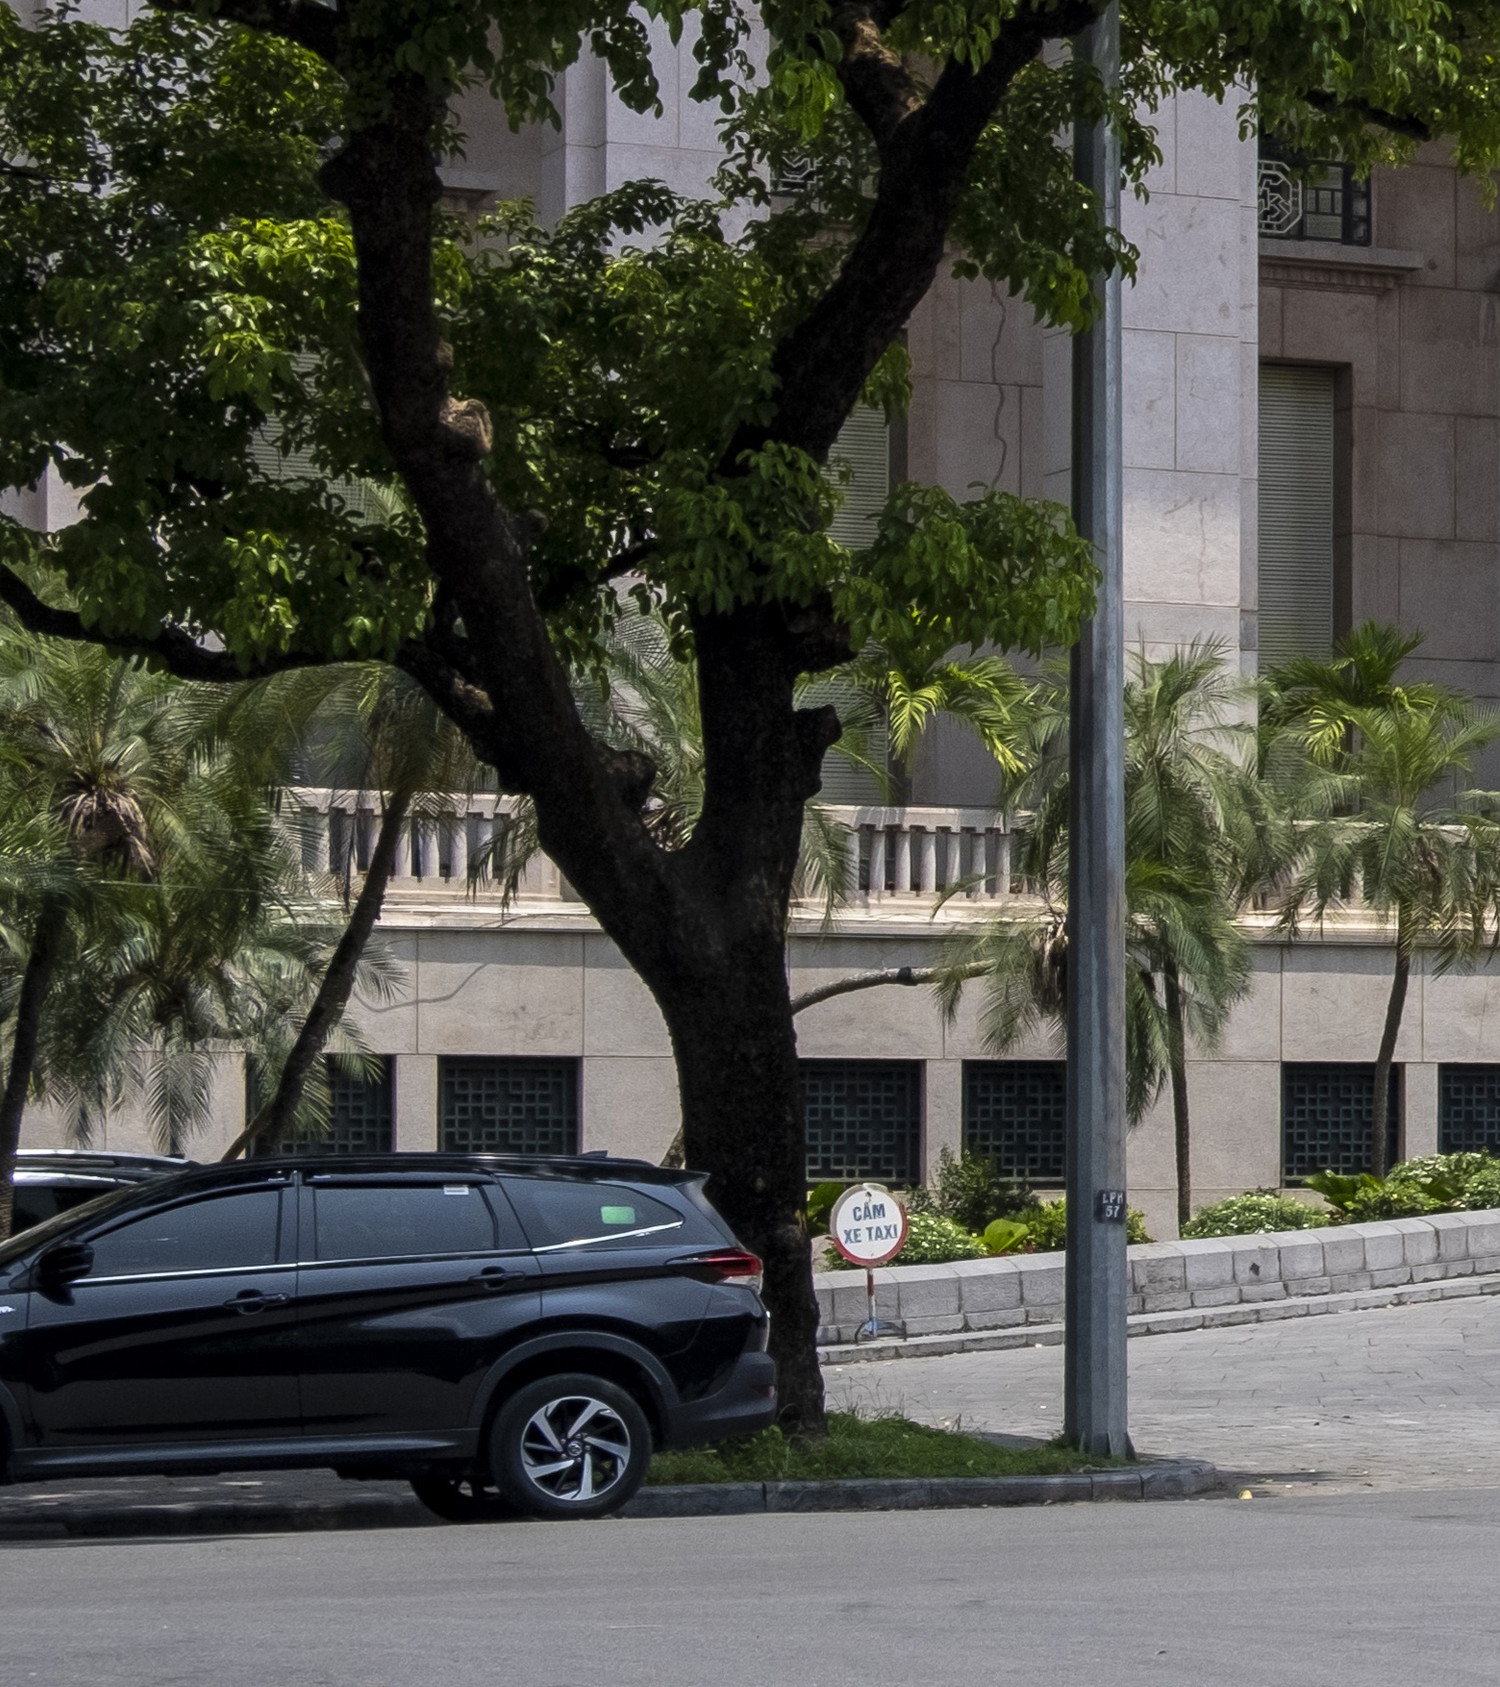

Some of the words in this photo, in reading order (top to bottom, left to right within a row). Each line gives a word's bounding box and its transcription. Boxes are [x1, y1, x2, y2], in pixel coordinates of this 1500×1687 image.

[1106, 1205, 1120, 1218] 57
[844, 1228, 862, 1245] XE
[866, 1224, 898, 1242] TAXI
